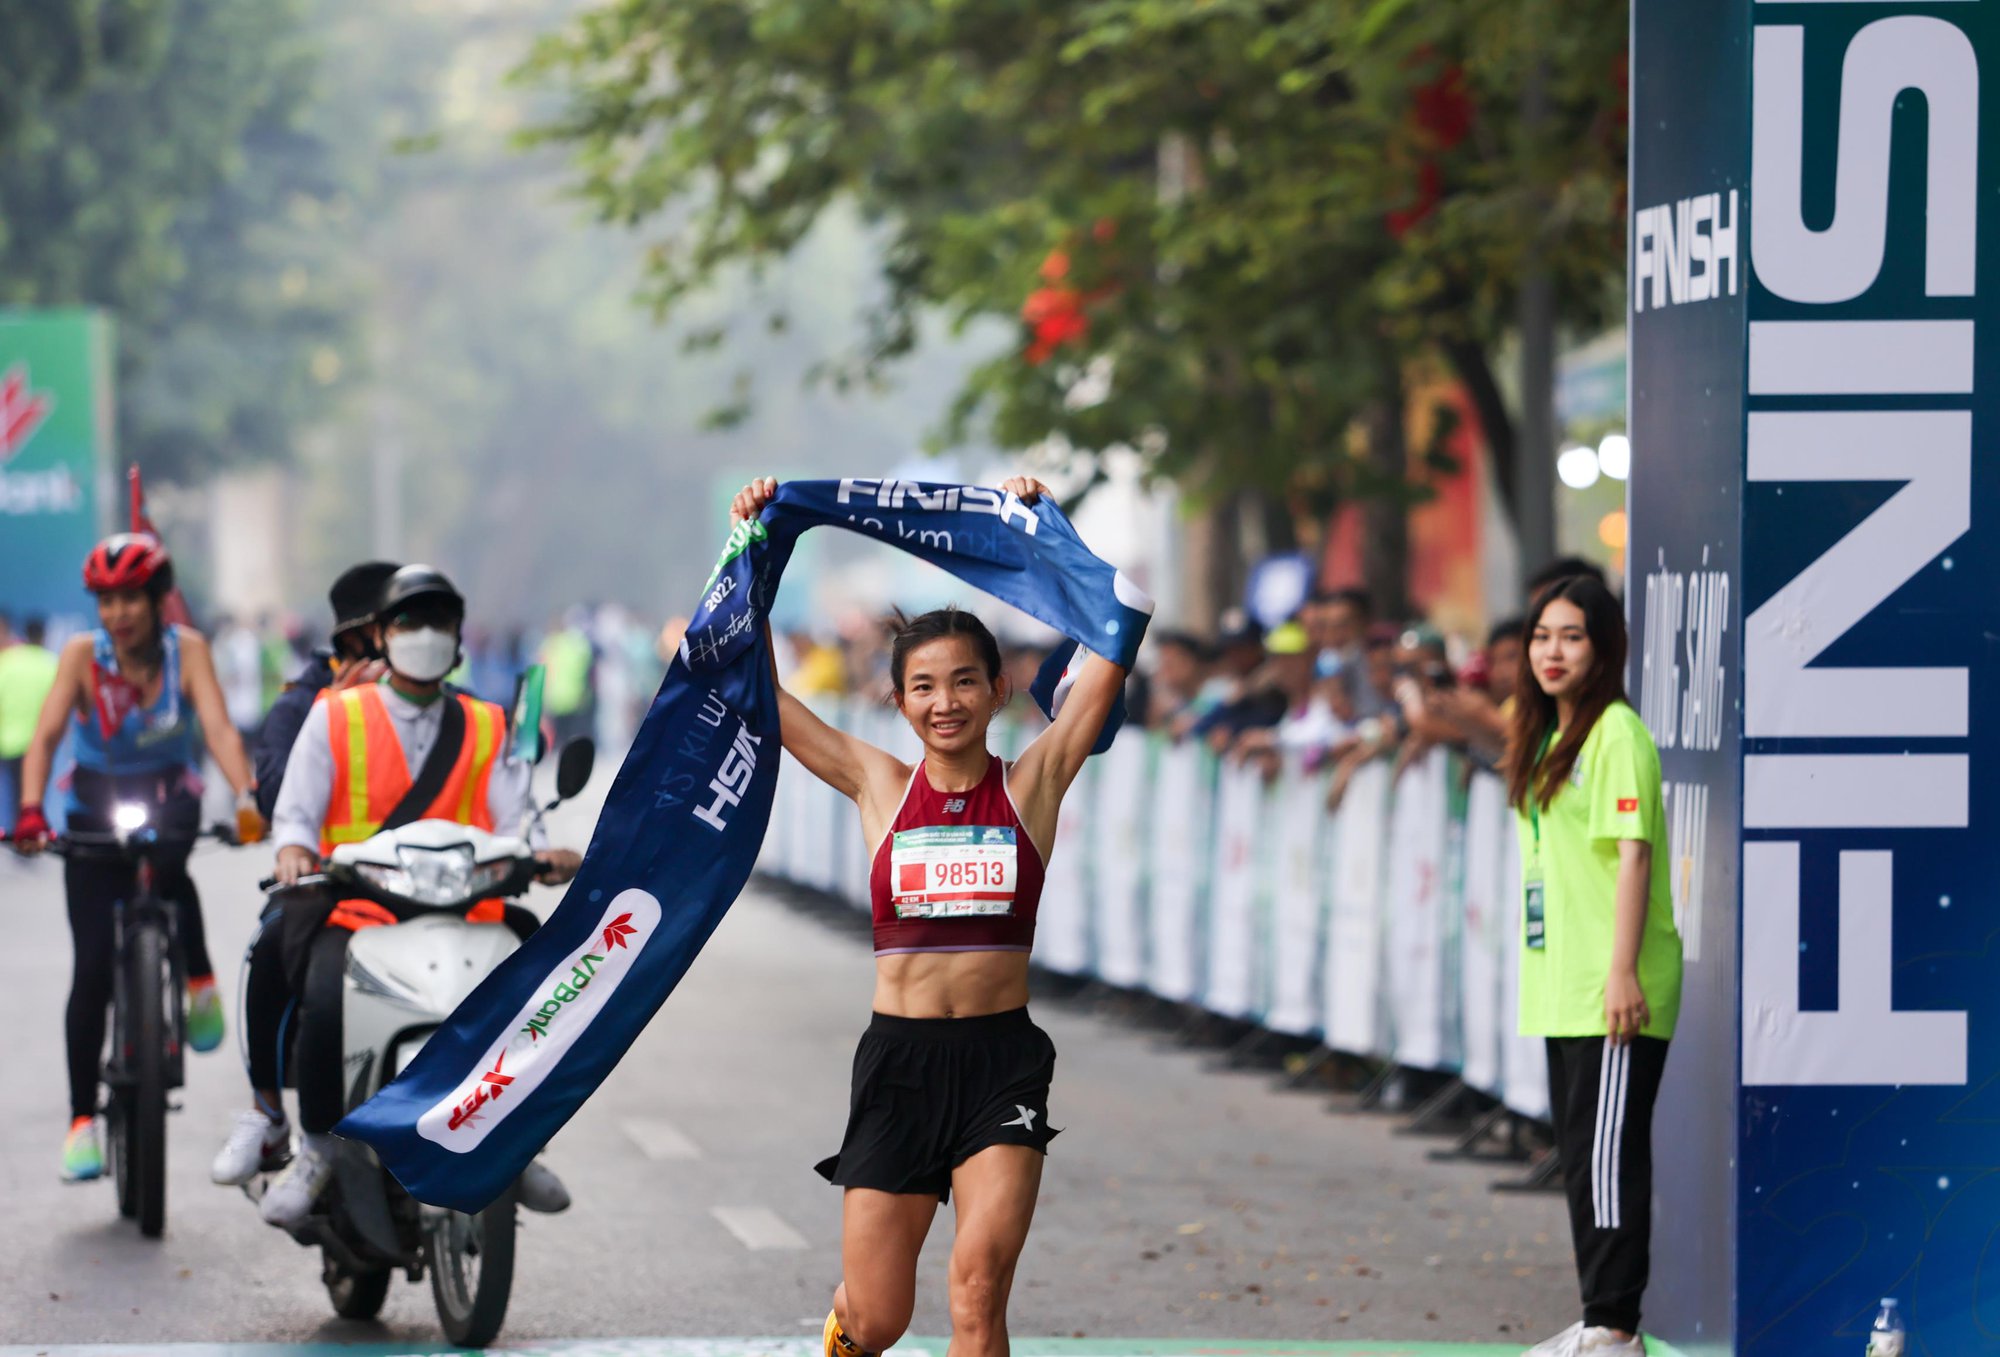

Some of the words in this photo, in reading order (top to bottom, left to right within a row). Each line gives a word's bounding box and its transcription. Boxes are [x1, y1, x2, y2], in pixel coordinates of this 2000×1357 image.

[1635, 189, 1738, 313] FINISH
[837, 478, 1040, 536] FINISH
[1742, 0, 1979, 1086] FINIS
[704, 575, 737, 613] 2022
[688, 607, 758, 663] Heritage
[935, 862, 1004, 887] 98513
[521, 954, 605, 1038] VPBank
[447, 1046, 516, 1131] XTEP
